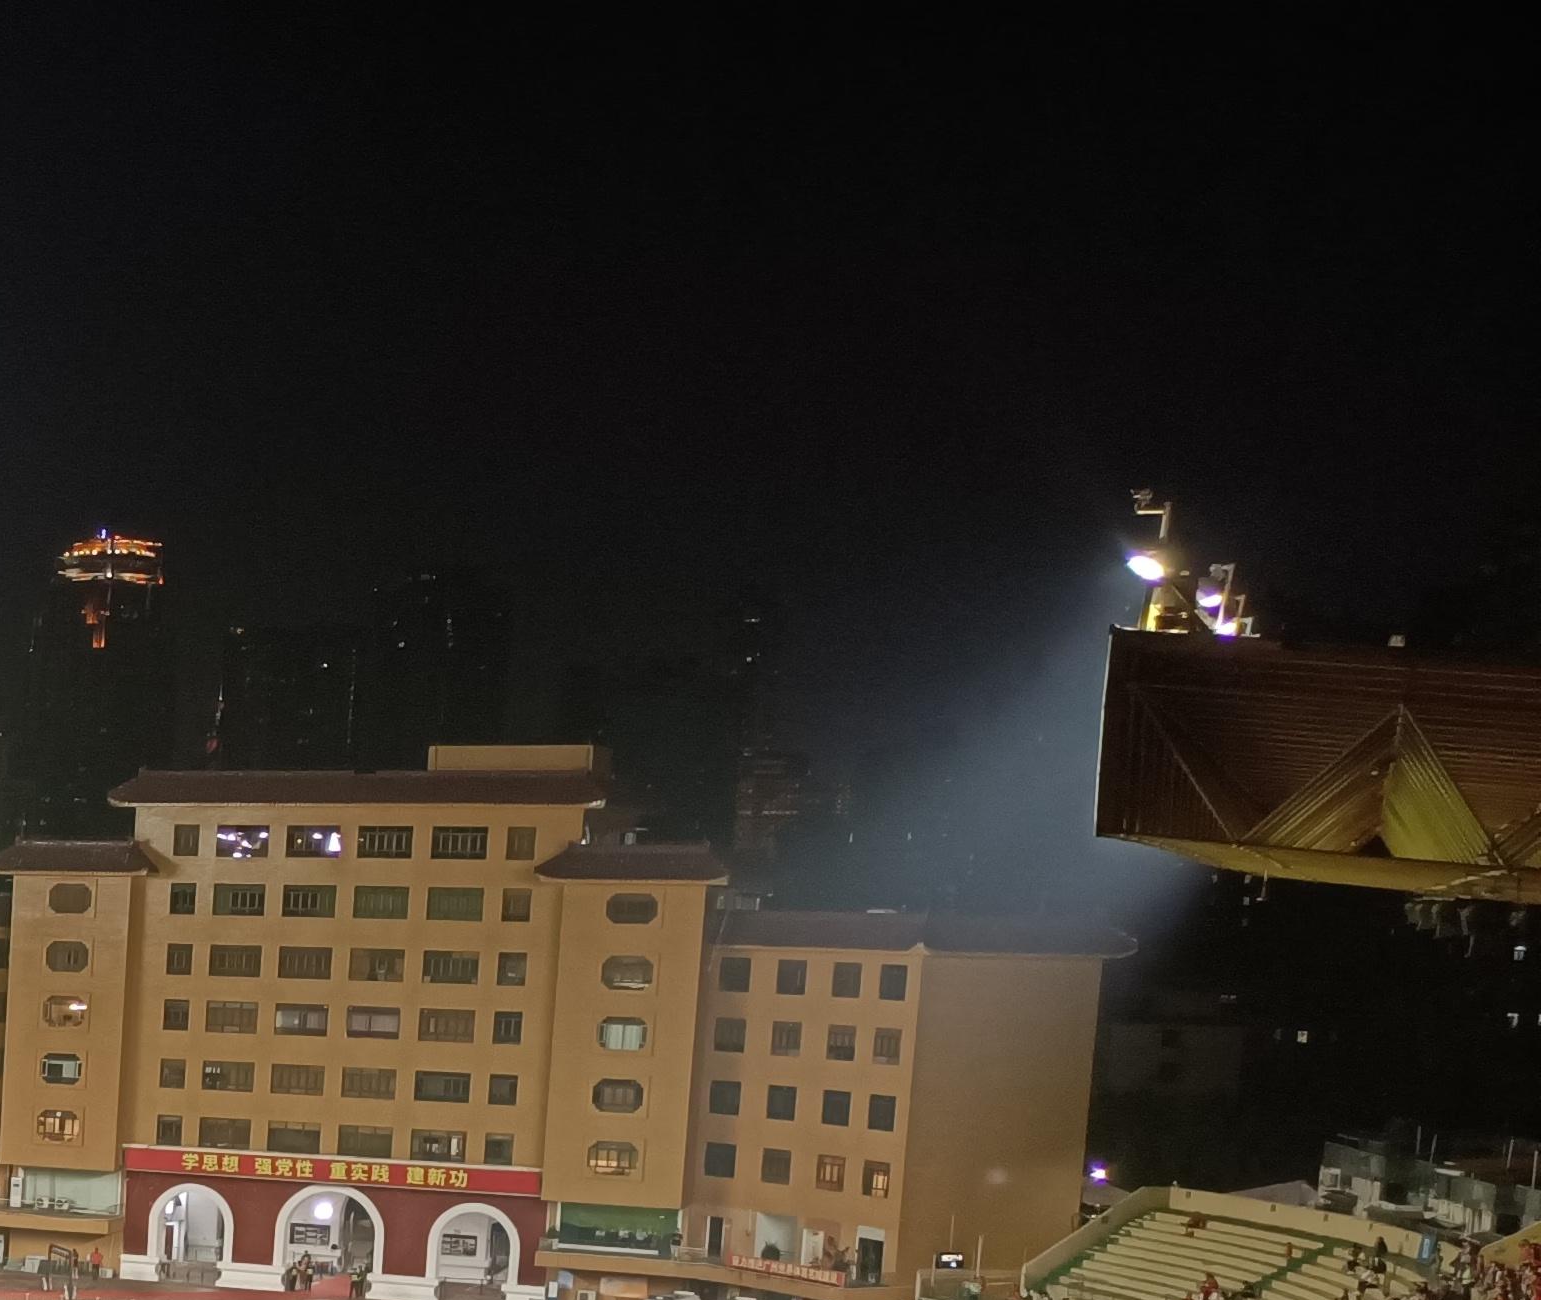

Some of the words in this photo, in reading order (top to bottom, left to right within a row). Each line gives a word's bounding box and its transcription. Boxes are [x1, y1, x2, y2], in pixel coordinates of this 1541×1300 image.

[181, 1153, 239, 1172] 学思想
[254, 1157, 314, 1178] 强党性
[329, 1162, 390, 1183] 重实践
[406, 1166, 469, 1188] 建新功
